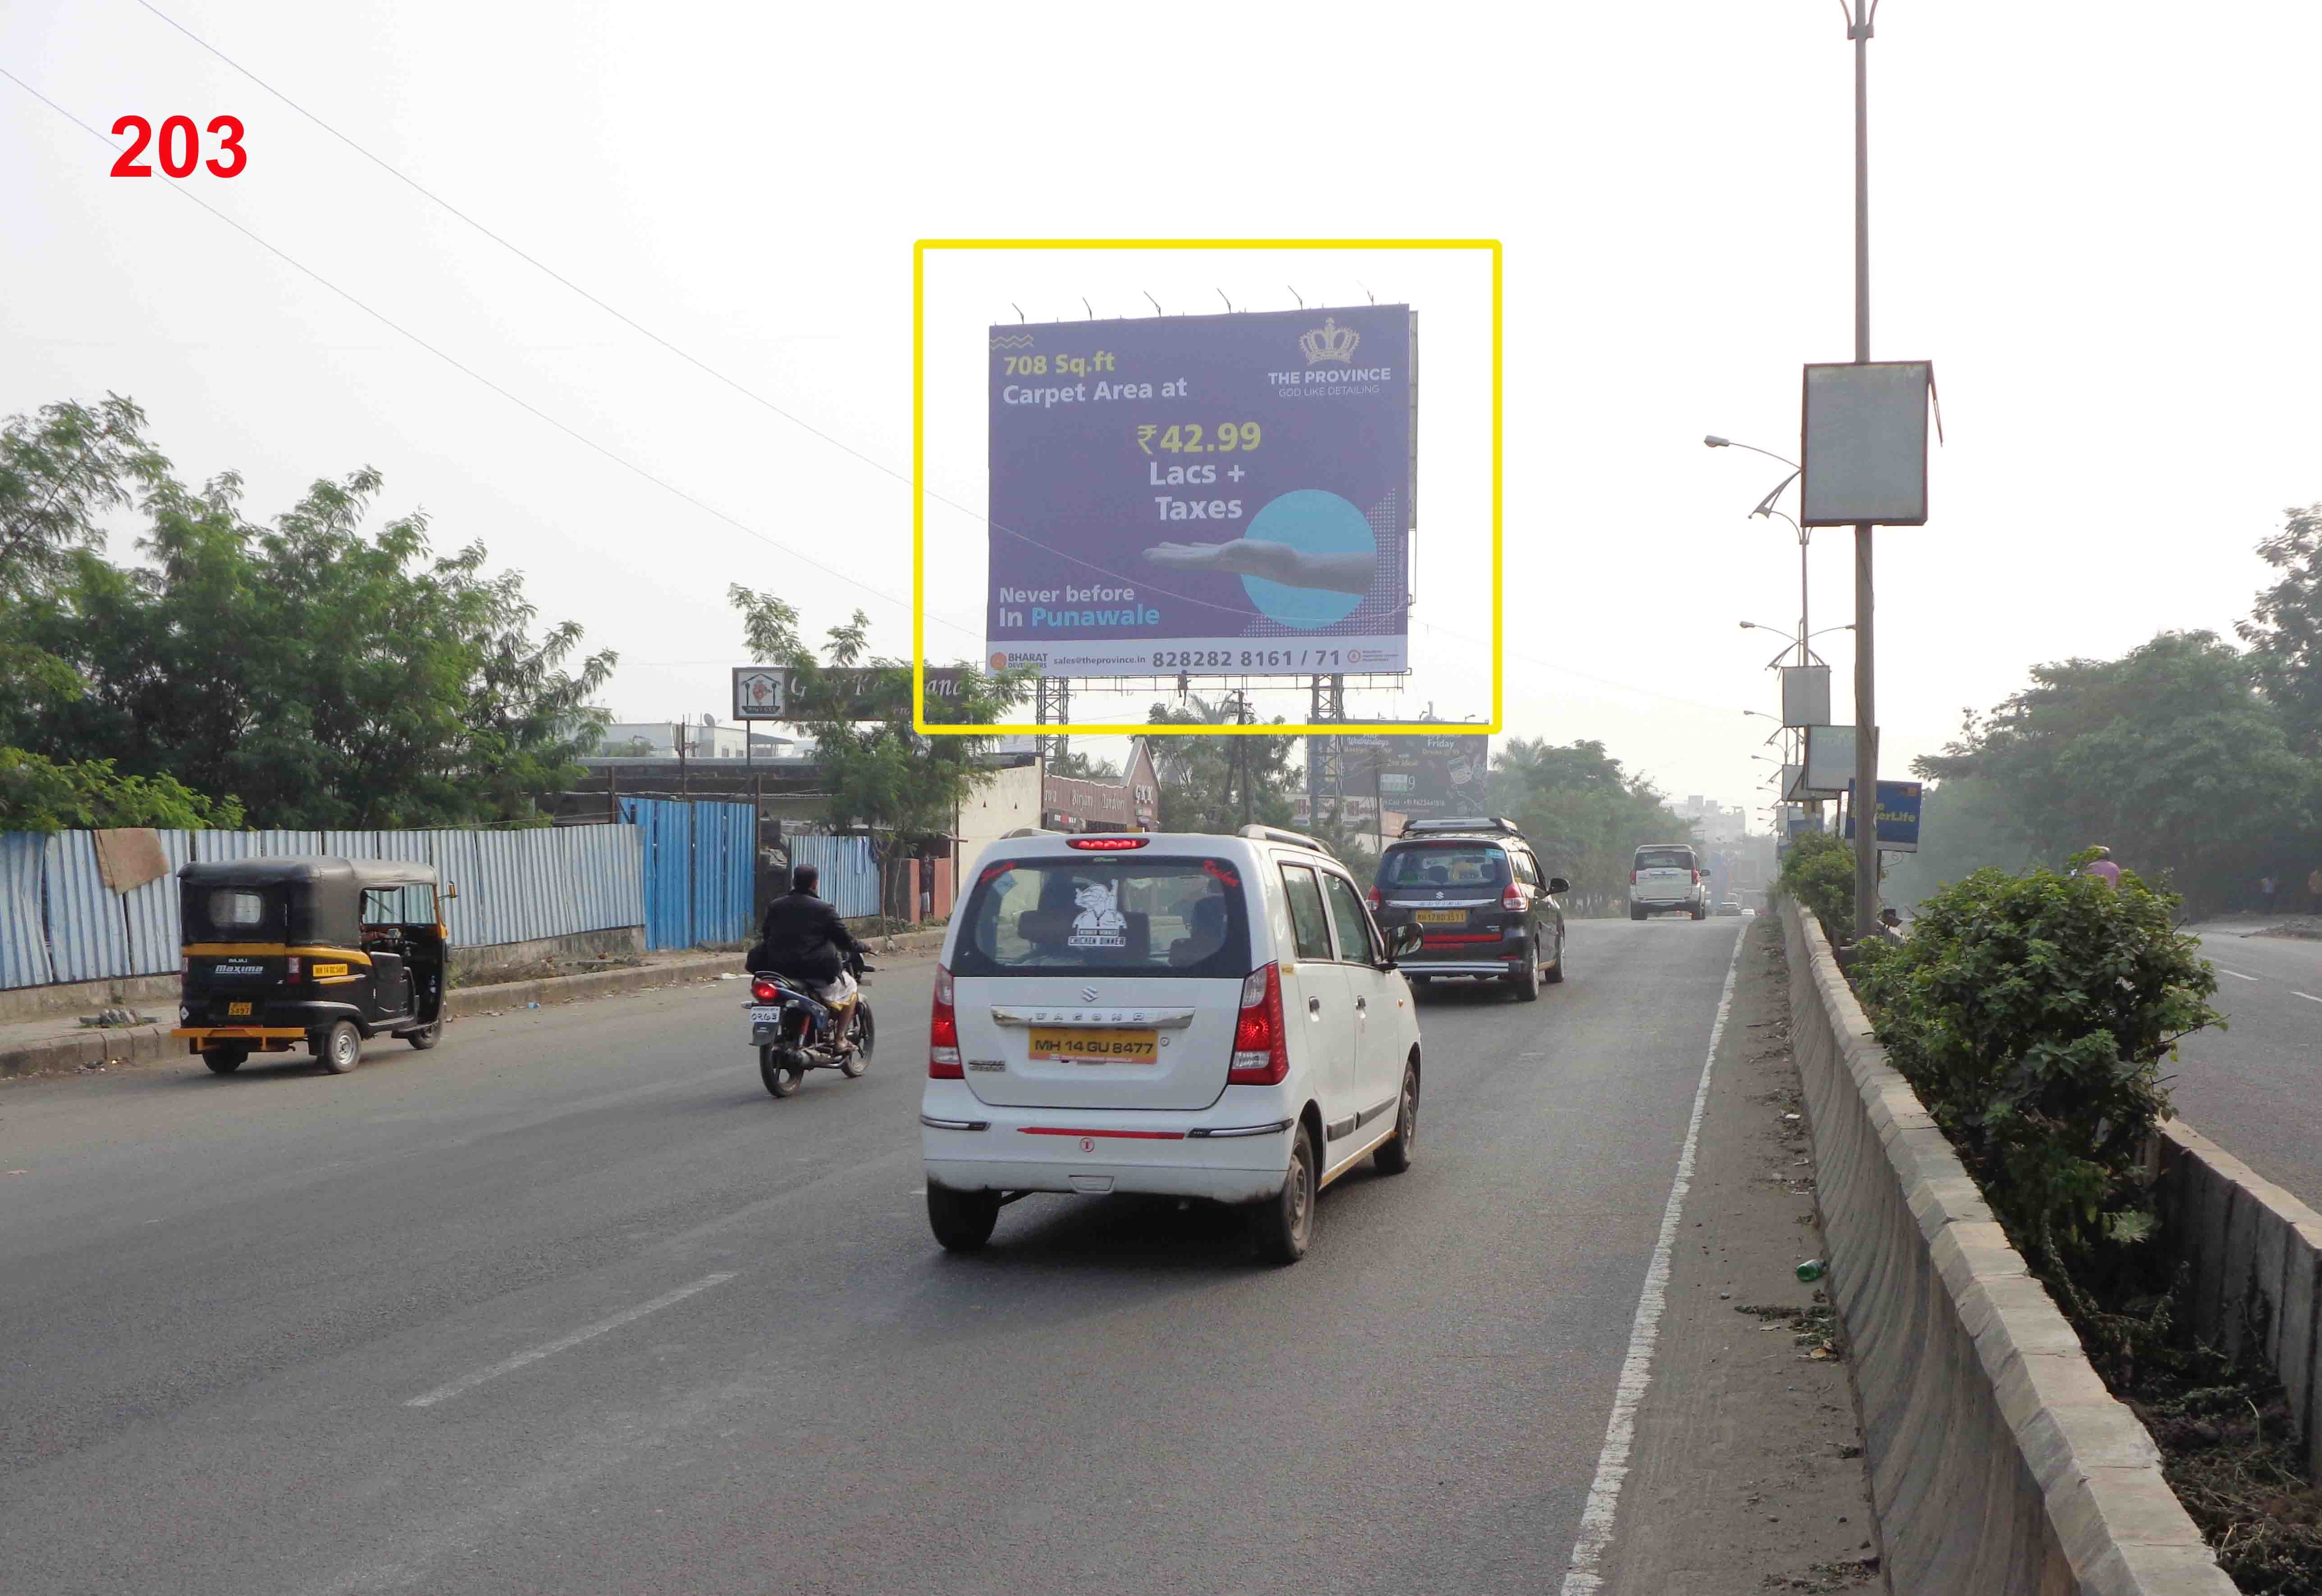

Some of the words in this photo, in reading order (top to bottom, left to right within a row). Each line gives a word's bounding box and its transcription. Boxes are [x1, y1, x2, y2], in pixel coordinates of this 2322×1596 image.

[1003, 355, 1048, 376] 708
[1055, 351, 1115, 377] Sq.ft
[1268, 371, 1301, 385] THE
[1305, 368, 1392, 383] PROVINCE
[1003, 383, 1086, 408] Carpet
[1093, 380, 1153, 400] Area
[1161, 376, 1188, 397] at
[1279, 389, 1301, 397] GOD
[1304, 387, 1325, 397] LIKE
[1328, 384, 1380, 396] DETAILING
[1150, 461, 1216, 485] Lacs
[1227, 464, 1245, 483] +
[1154, 496, 1243, 521] Taxes
[999, 587, 1060, 603] Never
[1065, 584, 1135, 602] before
[999, 606, 1023, 627] In
[1031, 604, 1161, 627] Punawale
[1008, 653, 1048, 662] BHARAT
[1053, 655, 1146, 666] sales@theprovince.in
[1152, 651, 1232, 668] 828282
[1240, 650, 1292, 667] 8161
[1301, 650, 1308, 666] /
[1316, 649, 1339, 666] 71
[1427, 739, 1455, 750] Friday
[215, 965, 263, 974] Maxima
[1035, 1039, 1061, 1051] MH
[1066, 1041, 1084, 1052] 14
[1086, 1041, 1110, 1053] GU
[1112, 1042, 1154, 1055] 8477
